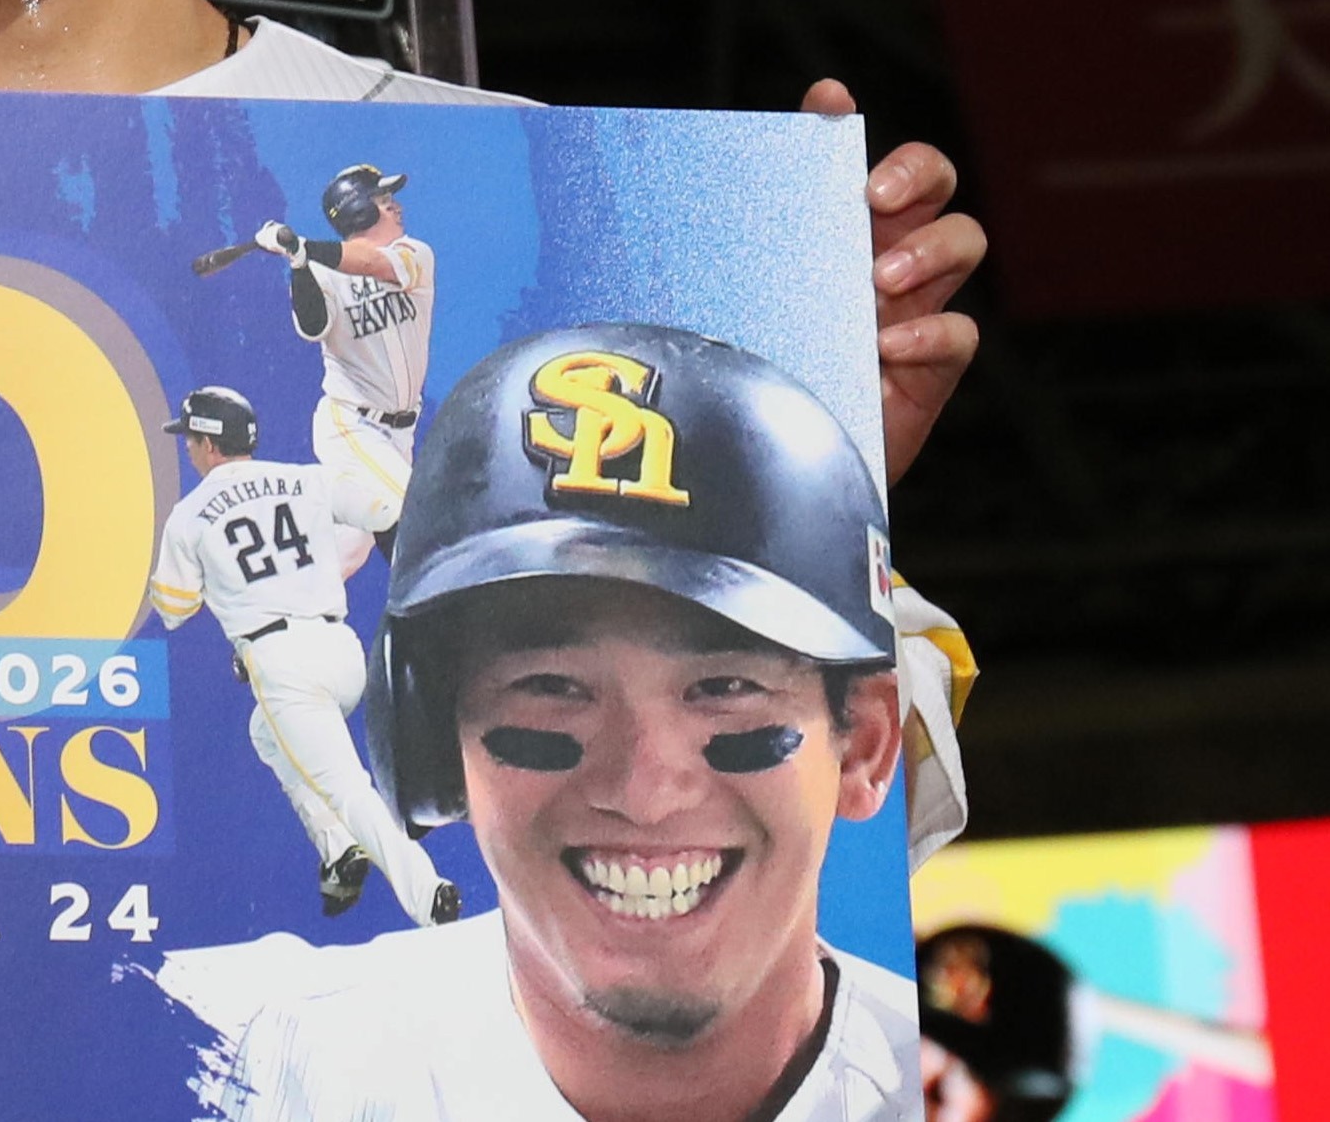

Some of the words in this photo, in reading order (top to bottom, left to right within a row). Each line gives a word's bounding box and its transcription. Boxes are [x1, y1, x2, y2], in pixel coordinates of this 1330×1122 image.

[197, 476, 304, 525] KURIHARA
[224, 502, 315, 584] 24
[47, 881, 160, 944] 24
